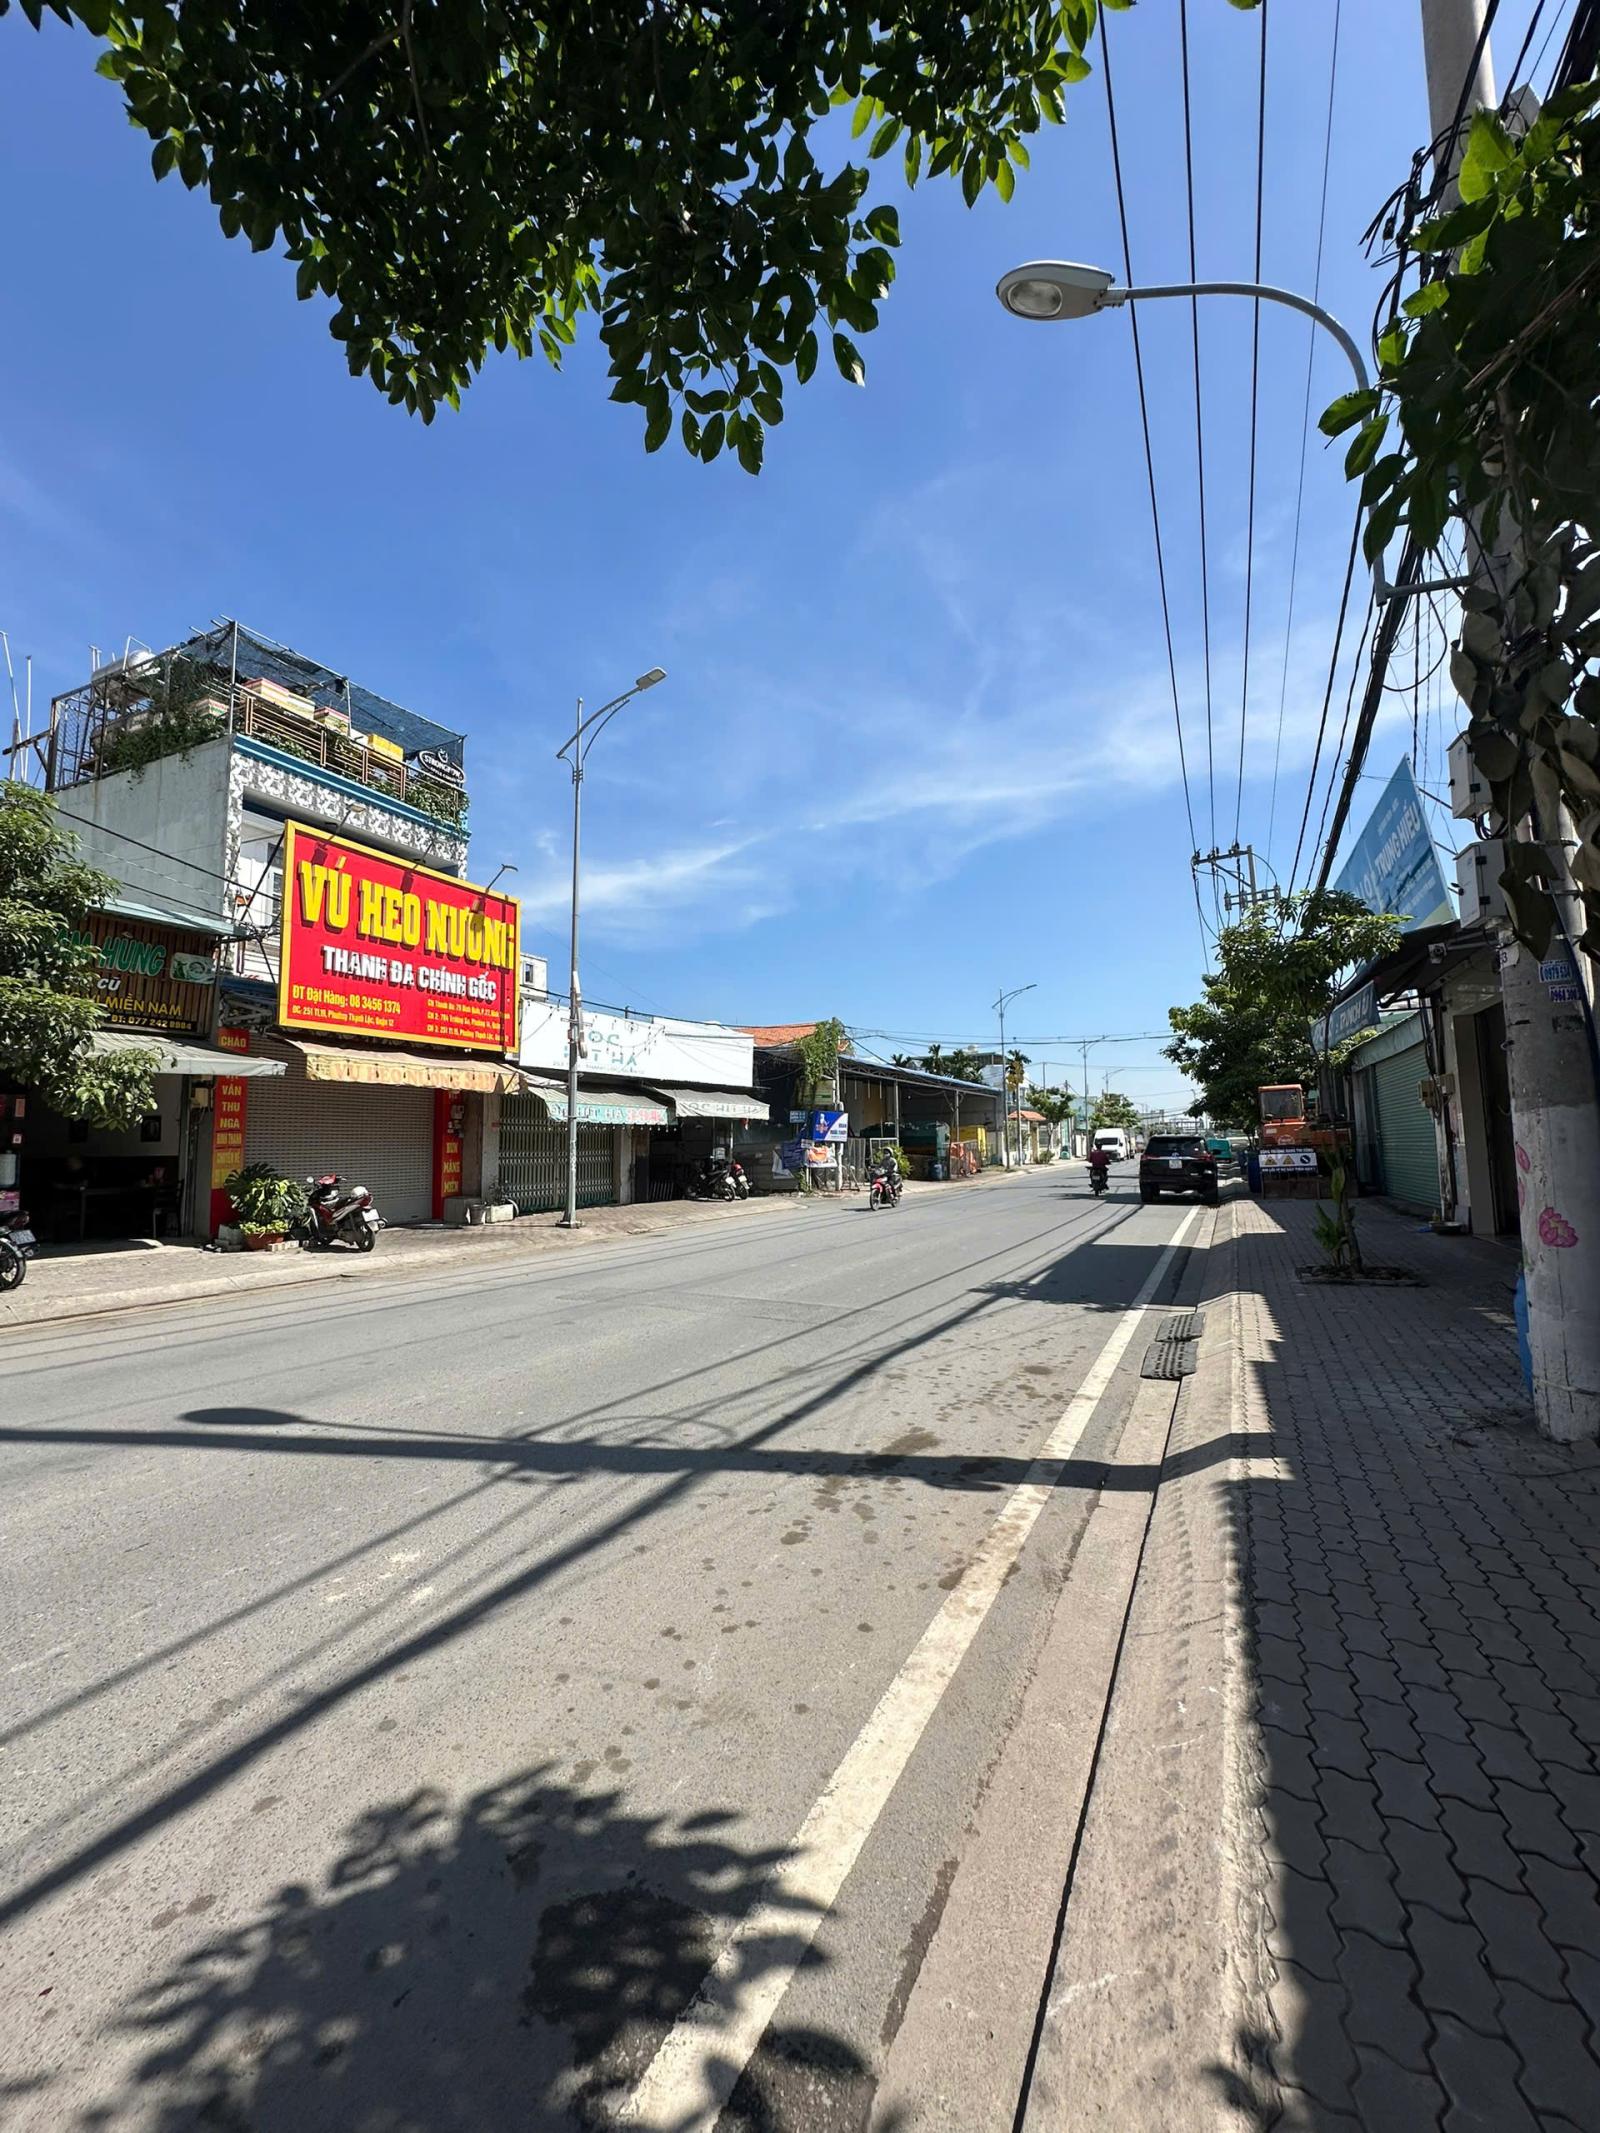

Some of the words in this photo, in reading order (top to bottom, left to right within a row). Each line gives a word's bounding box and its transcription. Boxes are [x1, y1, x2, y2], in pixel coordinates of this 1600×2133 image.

[299, 856, 352, 929] VÚ
[358, 879, 421, 946] HEO
[322, 945, 387, 979] THANH
[390, 960, 414, 986] ĐA
[419, 965, 466, 997] CHÍNH
[468, 971, 497, 1000] GỐC
[349, 993, 361, 1008] 08
[148, 1001, 182, 1017] NAM
[127, 1016, 148, 1026] 077
[149, 1018, 168, 1028] 242
[221, 1101, 241, 1112] THU
[220, 1118, 240, 1129] NGA
